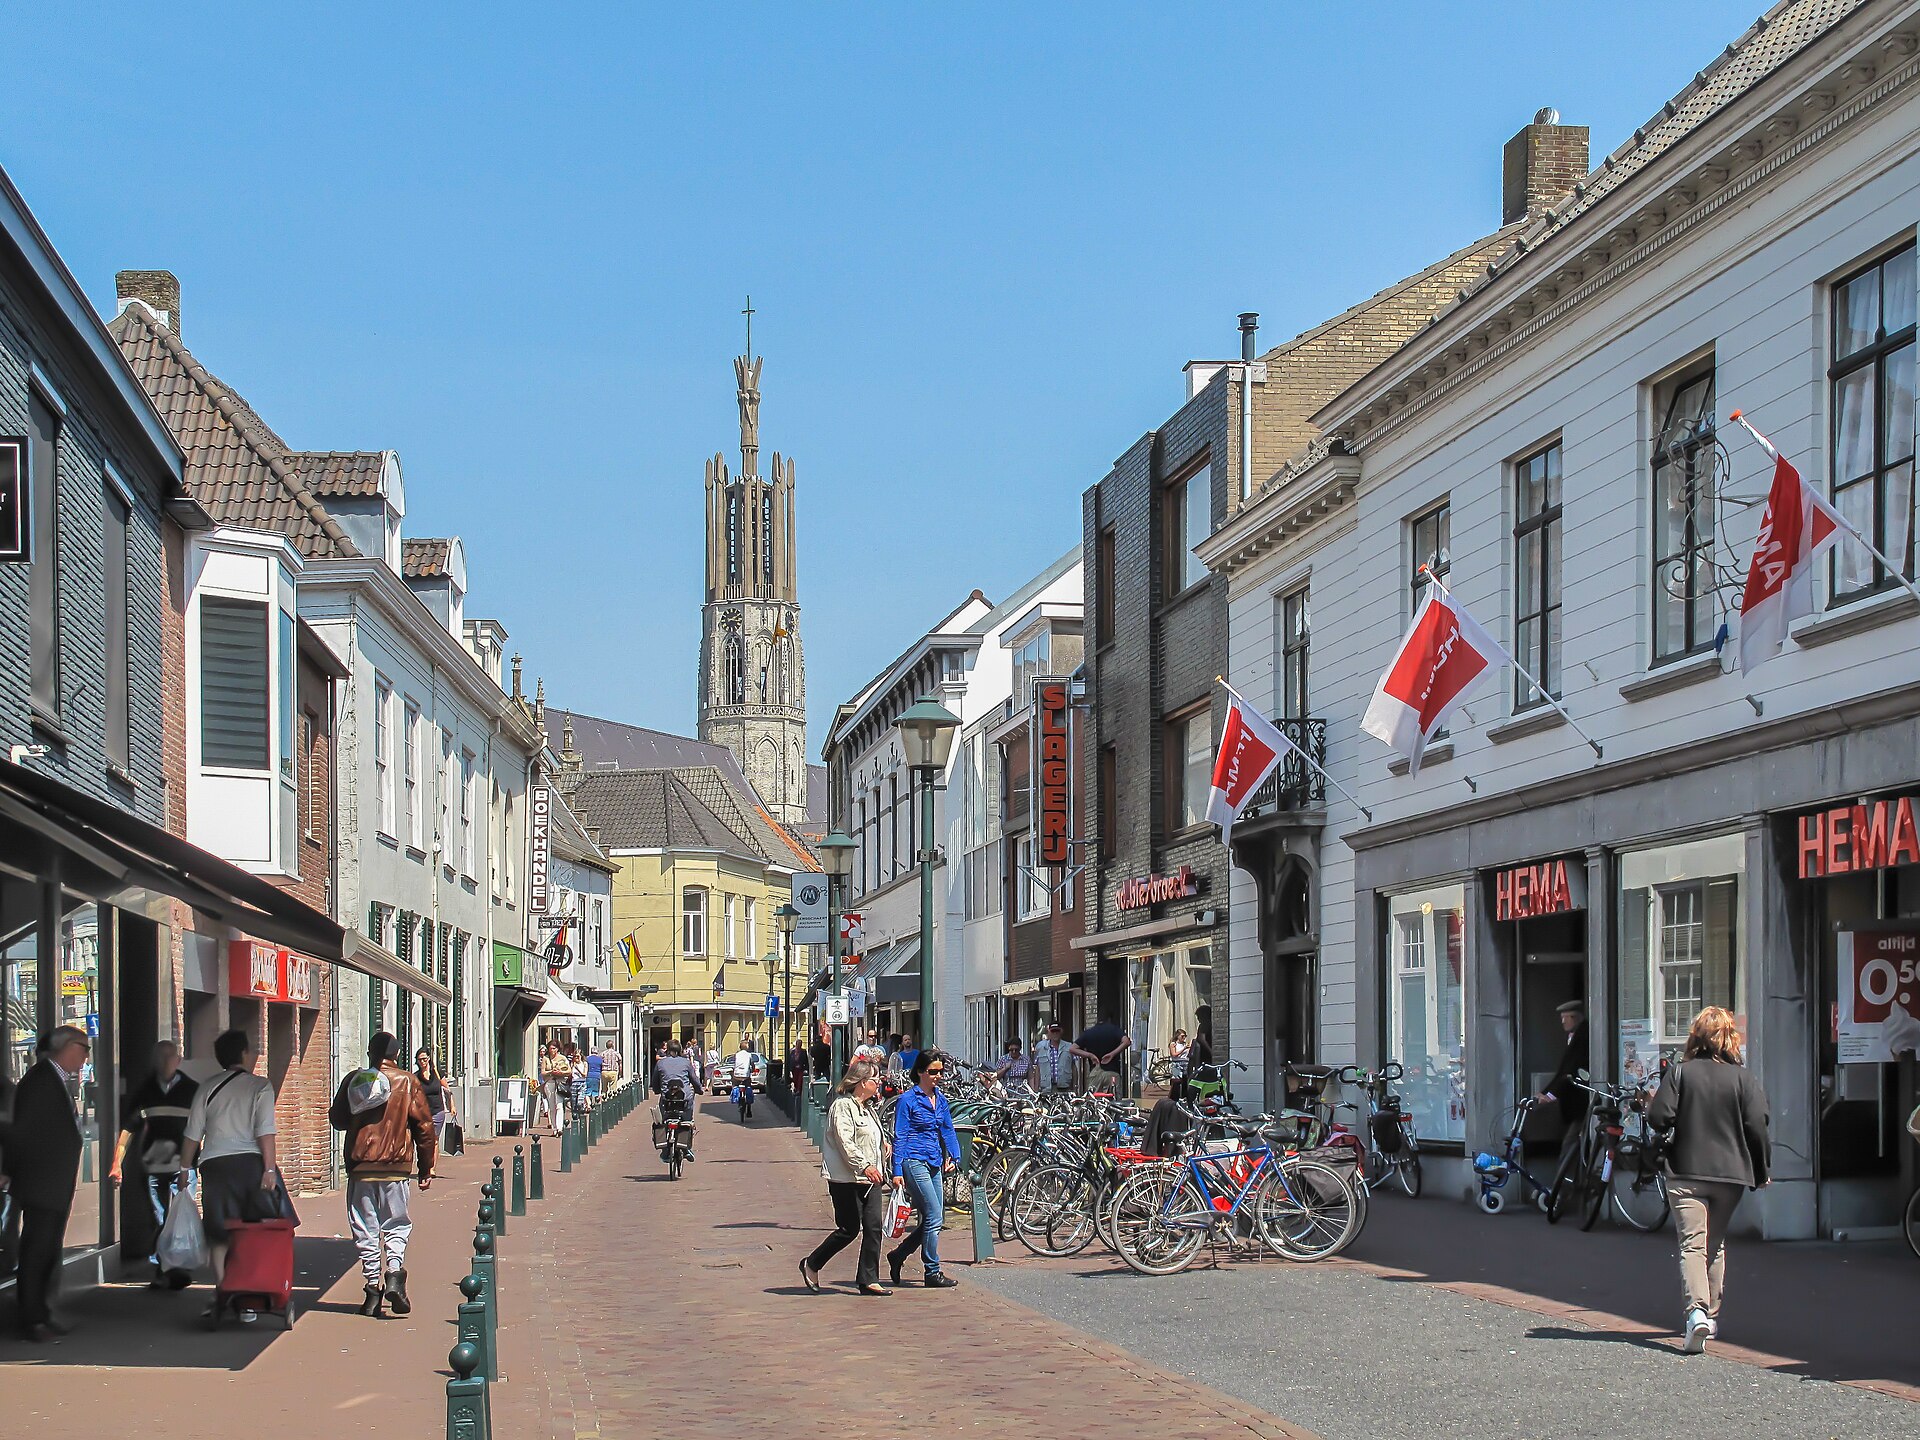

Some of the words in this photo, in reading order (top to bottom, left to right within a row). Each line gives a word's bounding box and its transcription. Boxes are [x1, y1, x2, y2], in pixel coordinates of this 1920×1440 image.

[532, 789, 549, 909] BOEKHANDEL
[1799, 796, 1920, 879] HEMA
[1497, 860, 1572, 921] HEMA
[1877, 935, 1916, 953] altijd
